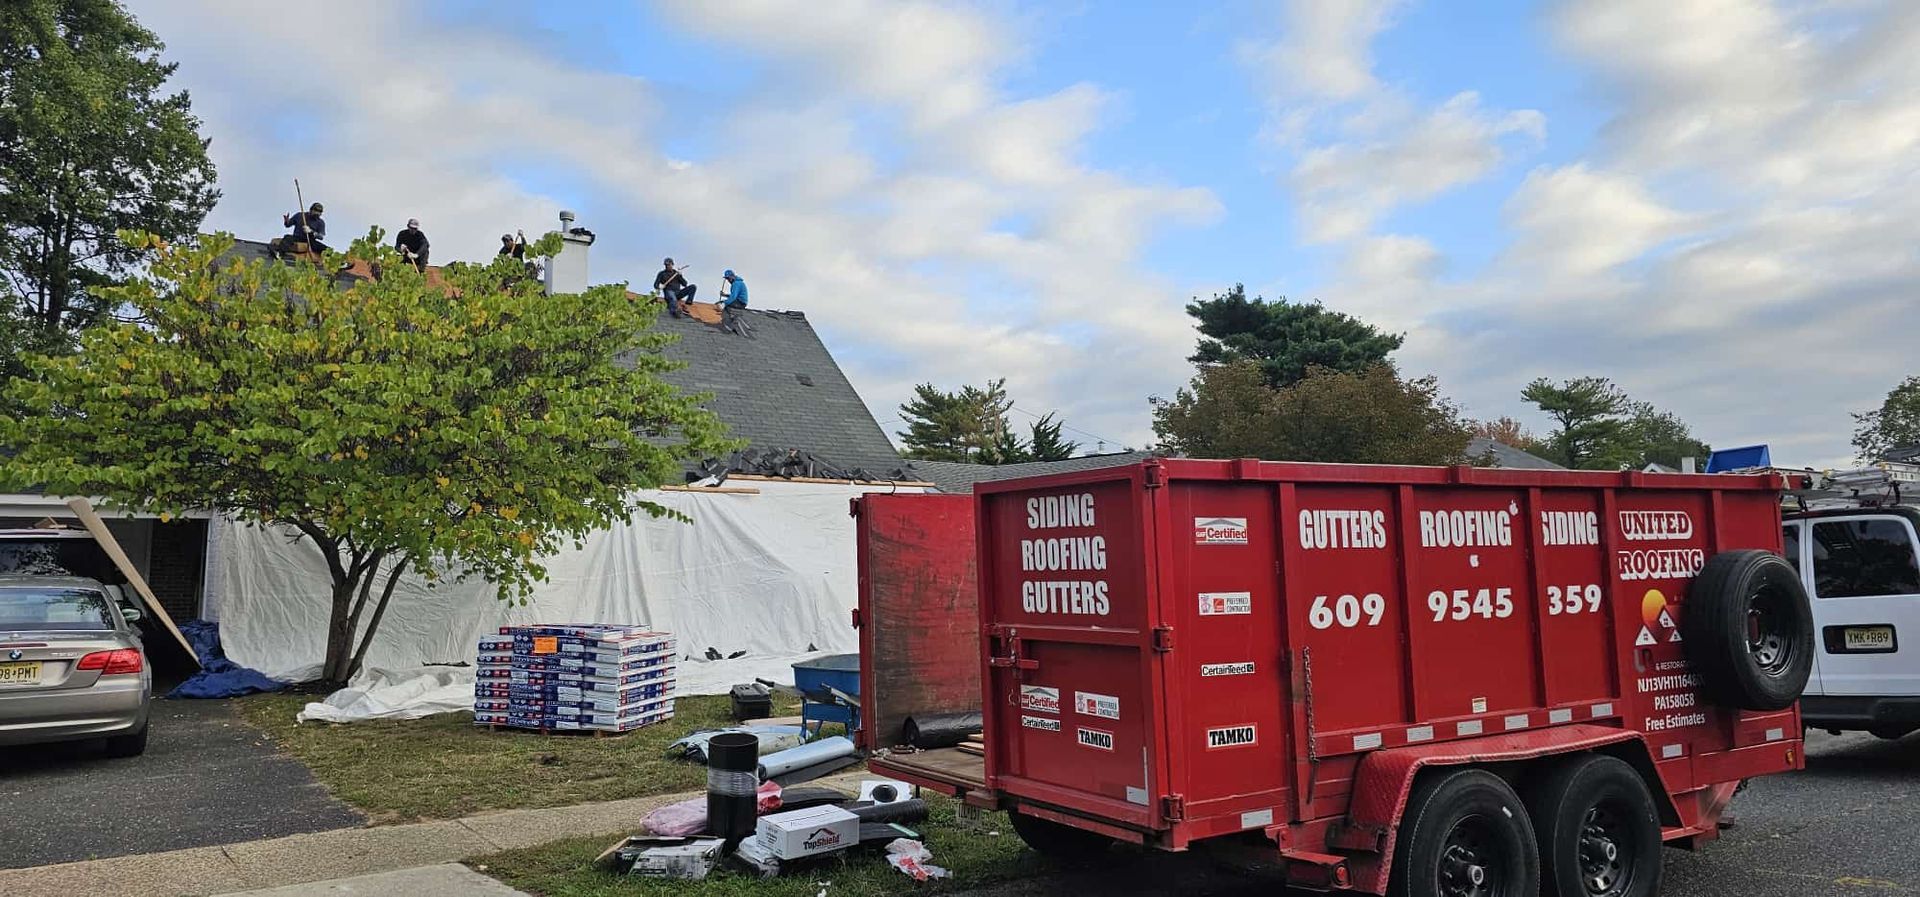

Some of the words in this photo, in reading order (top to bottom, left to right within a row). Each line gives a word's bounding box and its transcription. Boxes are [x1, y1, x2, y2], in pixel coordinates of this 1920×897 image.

[1026, 493, 1095, 529] SIDING
[1207, 527, 1248, 539] Certified
[1299, 509, 1386, 549] GUTTERS
[1420, 510, 1512, 547] ROOFING
[1619, 511, 1693, 540] UNITED
[1021, 536, 1107, 570] ROOFING
[1618, 549, 1704, 580] ROOFING
[1022, 581, 1110, 615] GUTTERS
[1309, 593, 1385, 629] 609
[1428, 588, 1514, 621] 9545
[1547, 584, 1602, 615] 359
[1202, 664, 1246, 676] CertainTeed
[1654, 693, 1695, 711] PA158058
[1645, 716, 1665, 731] Free
[1666, 713, 1706, 729] Estimates
[1079, 729, 1111, 748] TAMKO
[1209, 727, 1254, 746] TAMKO
[803, 833, 840, 850] TopShield
